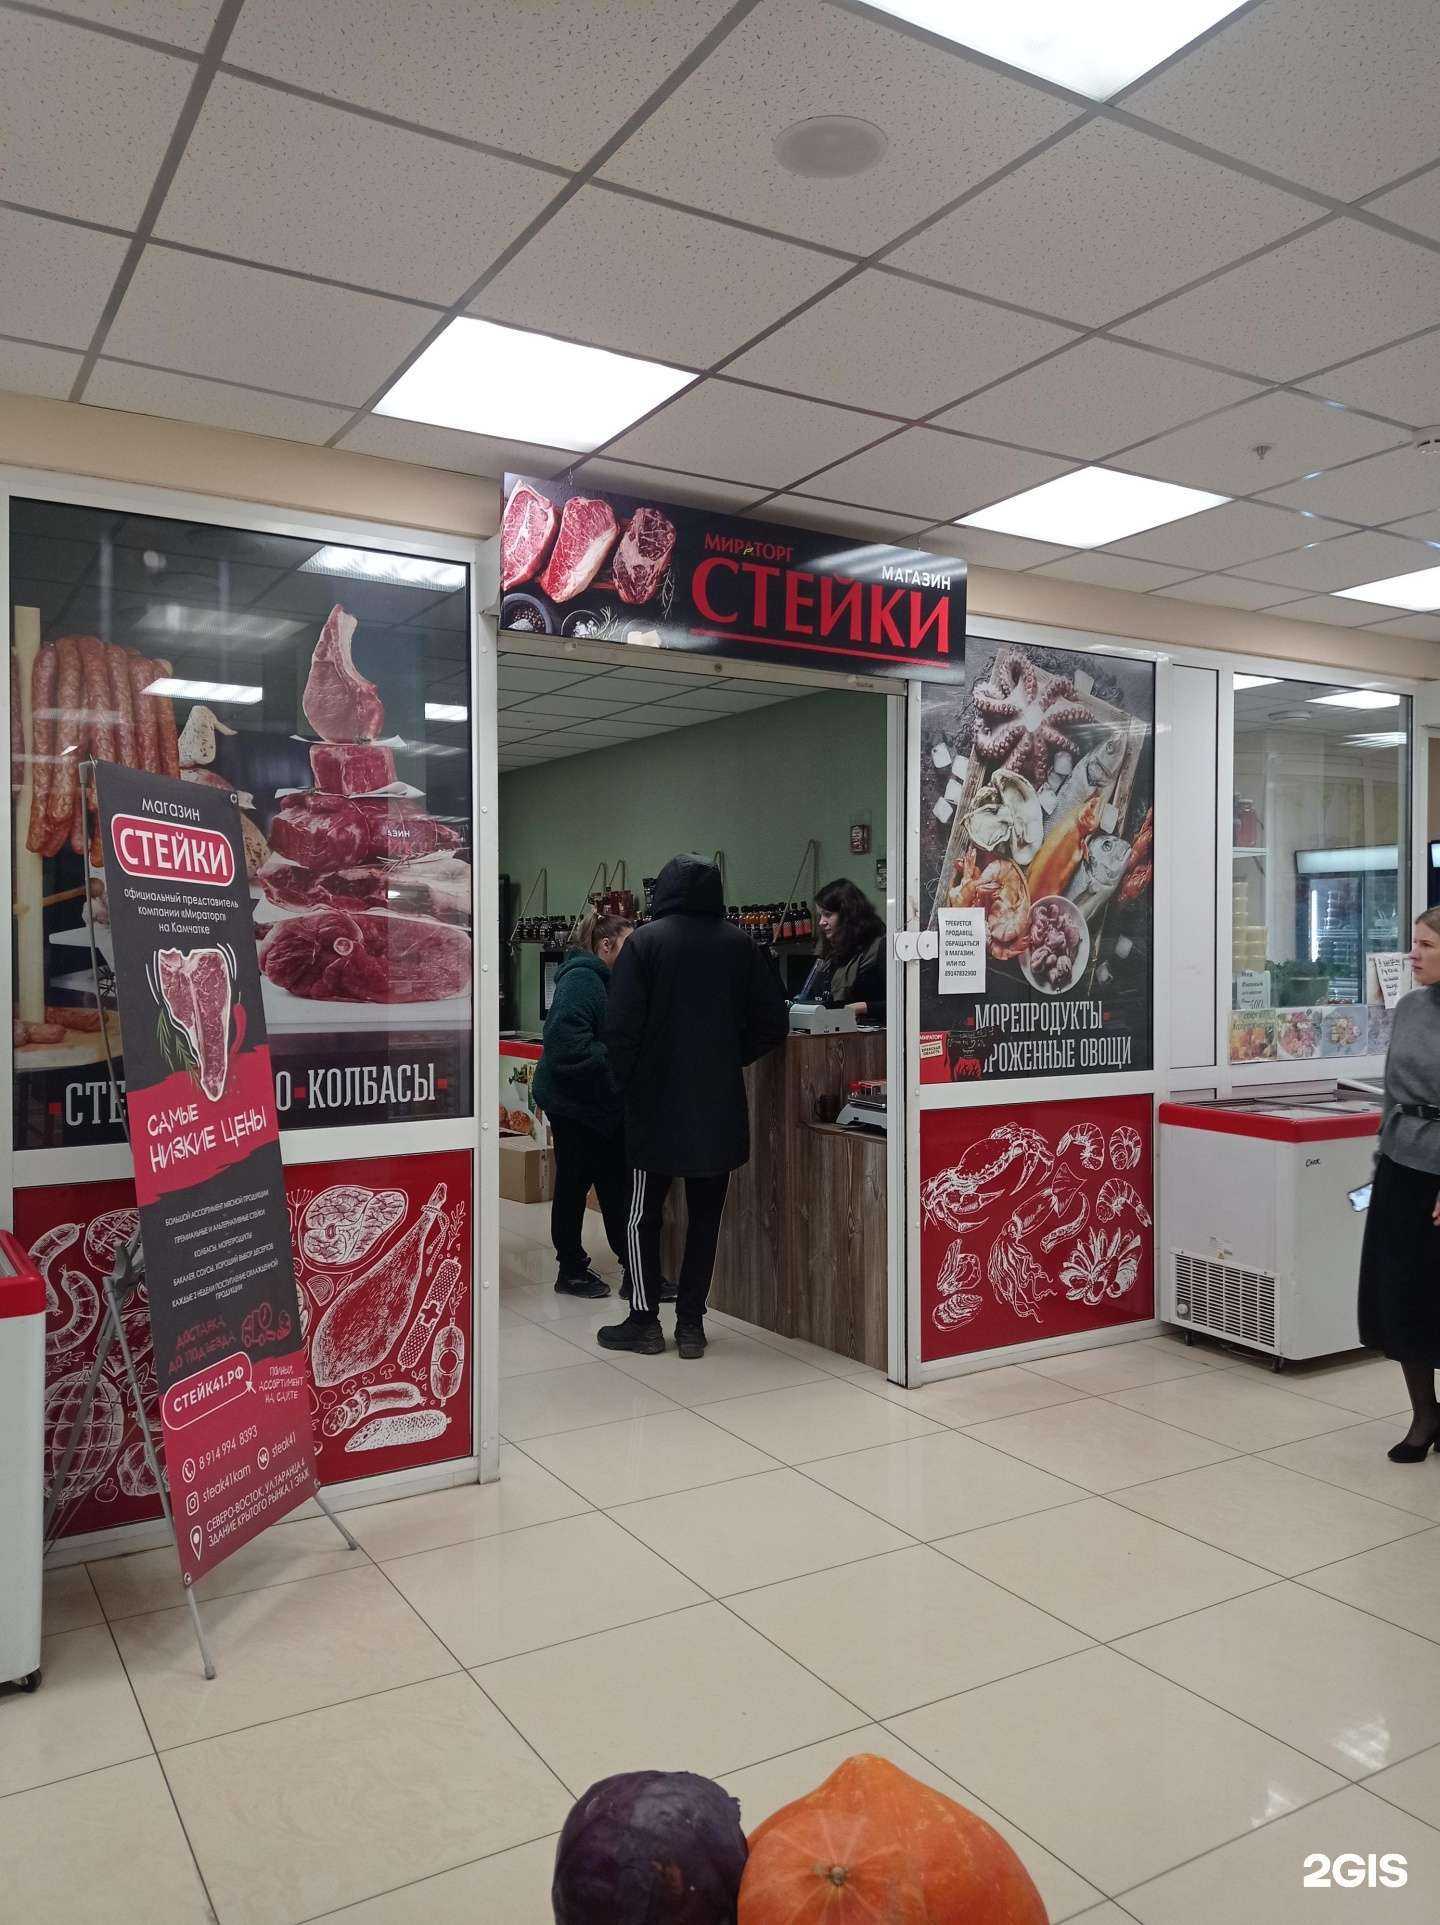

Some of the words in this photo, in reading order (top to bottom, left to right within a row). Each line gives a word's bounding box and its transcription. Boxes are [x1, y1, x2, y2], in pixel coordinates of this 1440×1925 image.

[881, 565, 951, 591] МАГАЗИН
[691, 556, 951, 654] СТЕЙКИ
[141, 797, 200, 822] магазин
[120, 827, 228, 877] СТЕЙКИ
[124, 887, 181, 903] официальный
[182, 893, 239, 909] представитель
[137, 905, 180, 918] компании
[158, 924, 171, 933] на
[171, 922, 210, 935] Камчатке
[974, 1001, 1103, 1035] МОРЕПРОДУКТЫ
[1080, 1036, 1132, 1071] ОВОЩИ
[307, 1063, 436, 1110] КОЛБАСЫ
[147, 1104, 200, 1137] САМЫЕ
[149, 1125, 217, 1173] НИЗКИЕ
[220, 1106, 267, 1148] ЦЕНЫ
[173, 1365, 245, 1413] СТЕЙК41.РФ
[258, 1376, 304, 1392] АССОРТИМЕНТ
[265, 1393, 275, 1404] НА
[199, 1455, 206, 1470] 8
[239, 1425, 258, 1446] 8393
[271, 1431, 297, 1458] steak41
[202, 1464, 252, 1503] steak41kam
[207, 1518, 237, 1547] ЗДАНИЕ
[236, 1498, 268, 1528] КРЫТОГО
[294, 1467, 310, 1487] ЭТАЖ
